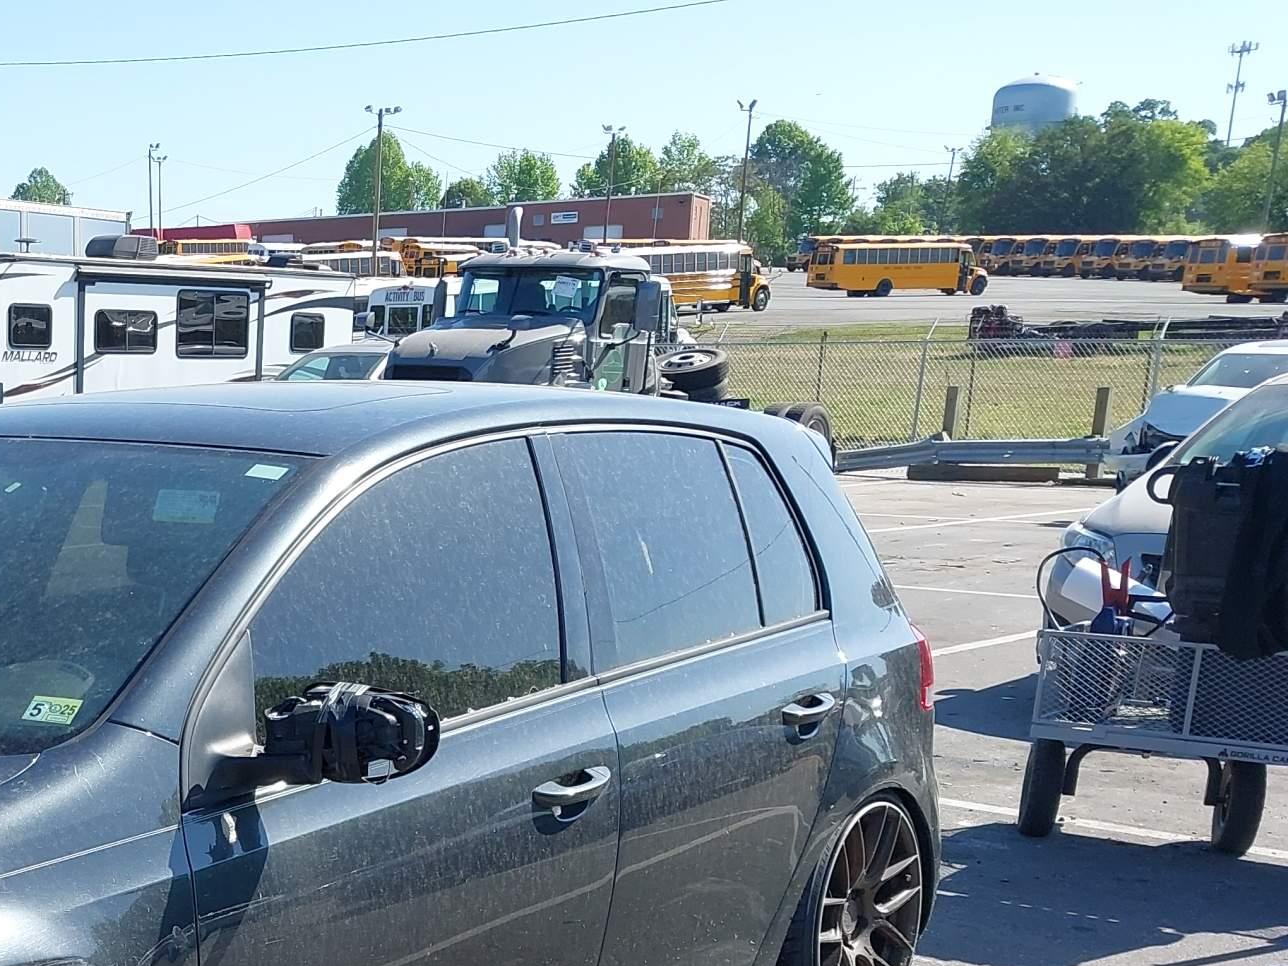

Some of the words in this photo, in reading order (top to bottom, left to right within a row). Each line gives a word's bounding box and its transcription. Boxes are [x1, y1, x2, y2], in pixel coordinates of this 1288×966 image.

[384, 290, 410, 302] ACTIVITY
[413, 291, 425, 301] BUS
[1, 351, 58, 362] MALLARD
[29, 702, 45, 717] 5
[59, 704, 78, 716] 25
[1230, 750, 1269, 761] GORILLA
